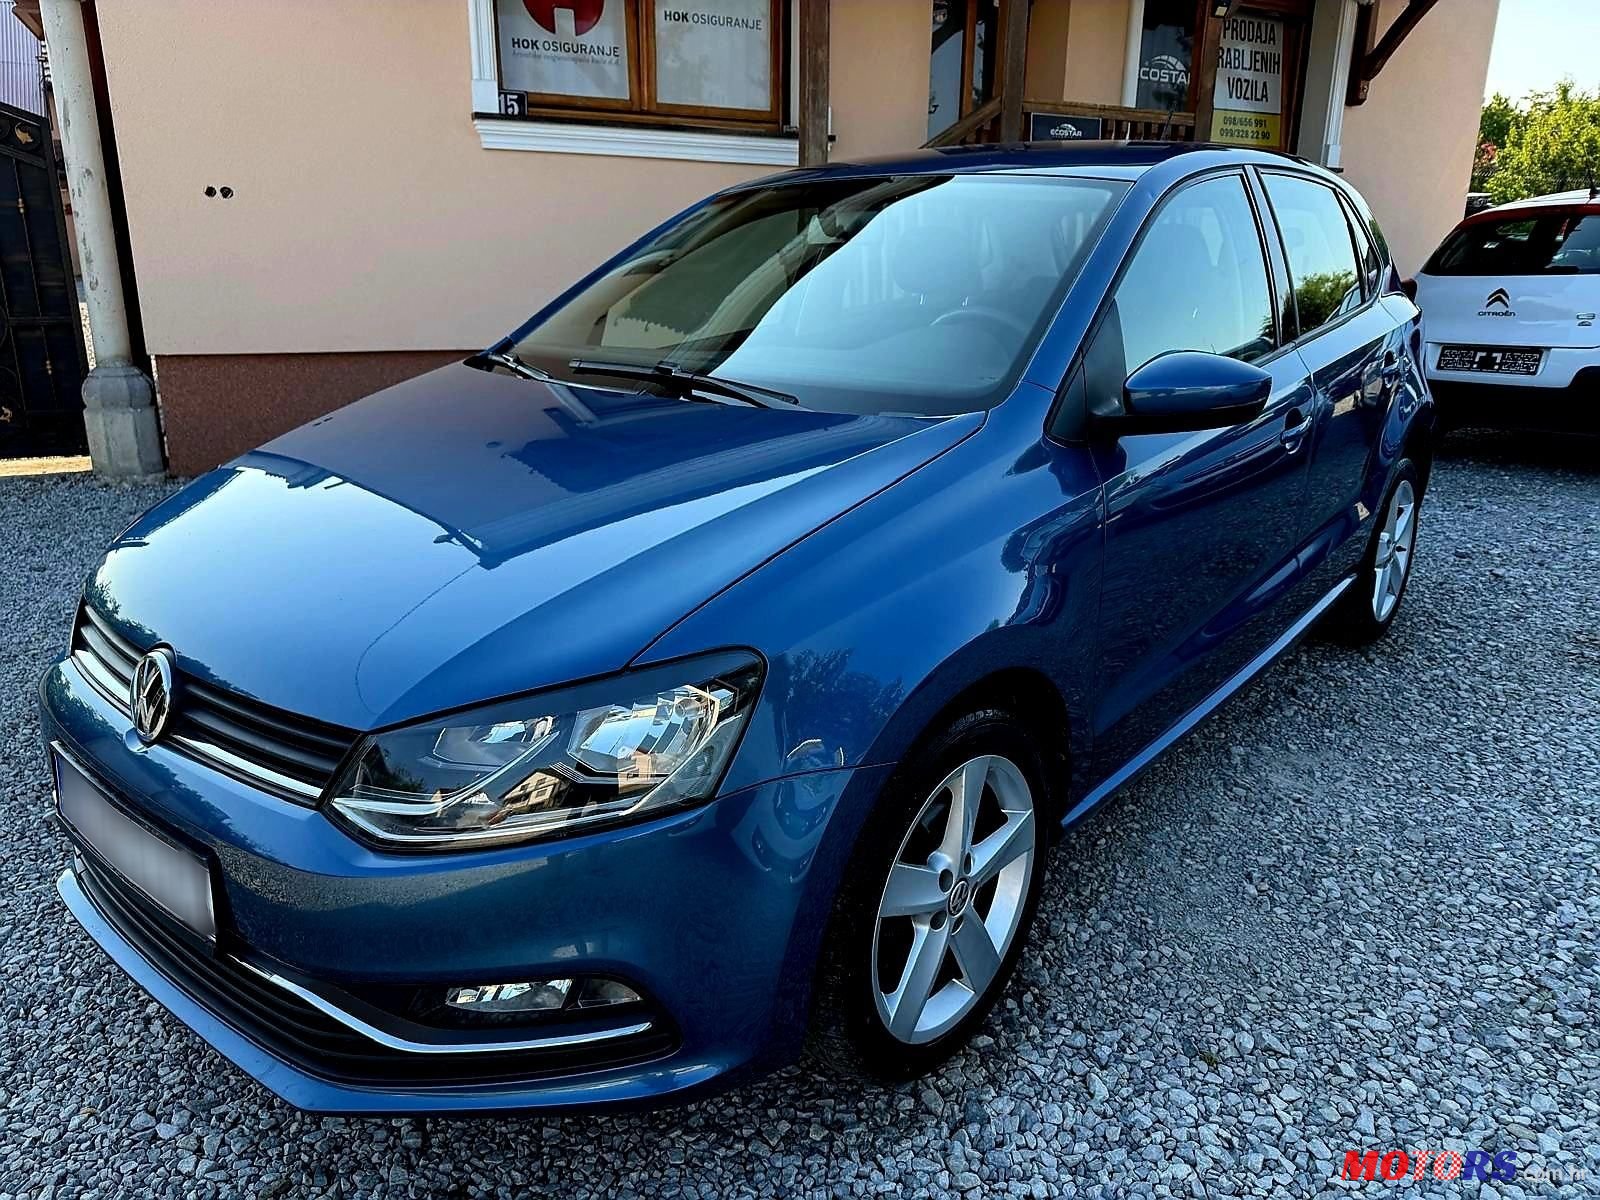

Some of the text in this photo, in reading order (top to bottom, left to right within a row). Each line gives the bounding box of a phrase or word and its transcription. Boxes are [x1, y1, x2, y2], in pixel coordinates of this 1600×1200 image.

[664, 10, 762, 31] HOK OSIGURANJE
[1222, 18, 1276, 45] PRODAJA
[511, 37, 540, 50] HOK
[542, 40, 620, 57] OSIGURANJE
[1217, 47, 1281, 75] RABLJENIH
[1140, 67, 1191, 85] COSTA
[1227, 77, 1269, 103] VOZILA
[500, 94, 519, 116] 15
[1250, 130, 1260, 140] 22
[1261, 130, 1271, 140] 90
